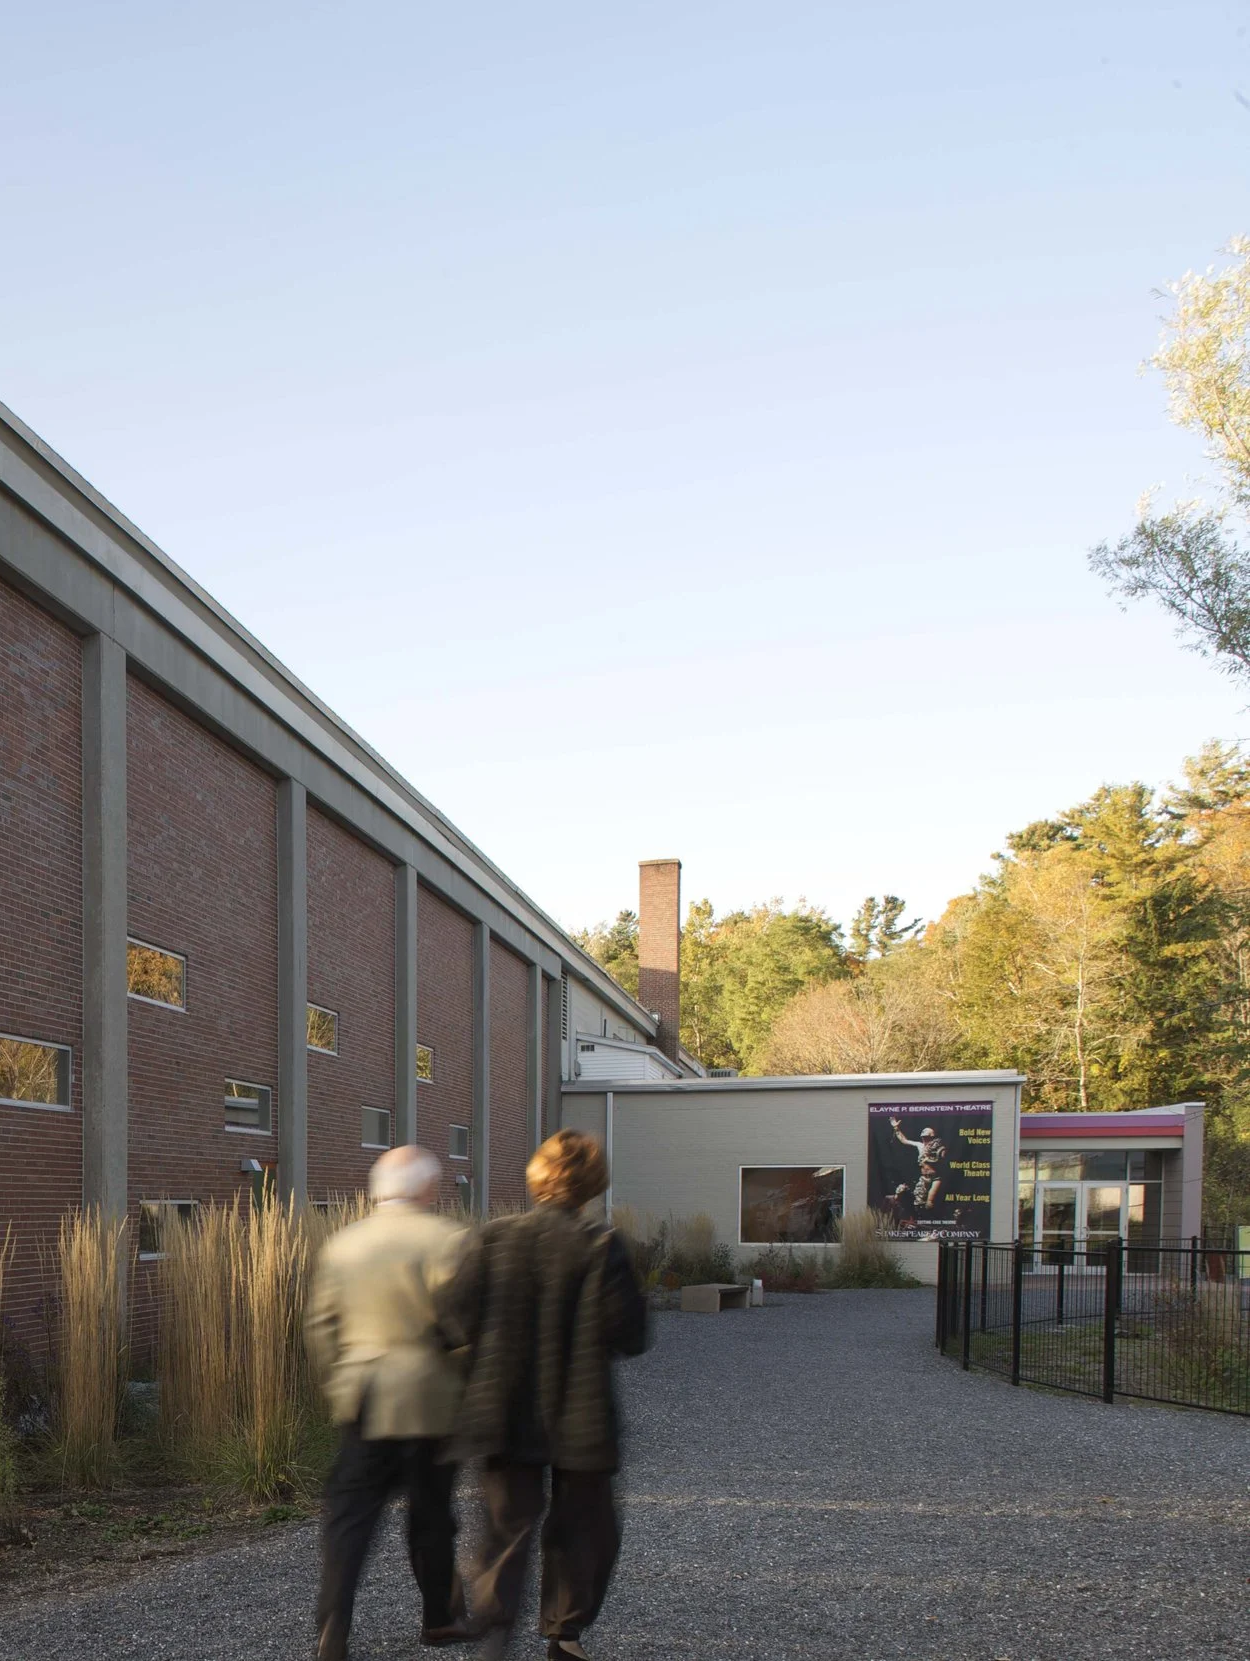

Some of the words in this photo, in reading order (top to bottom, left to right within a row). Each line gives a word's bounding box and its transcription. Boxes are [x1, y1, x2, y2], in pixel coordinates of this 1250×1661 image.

[959, 1128, 975, 1136] Bold
[976, 1128, 991, 1136] New
[949, 1161, 970, 1169] World
[971, 1161, 990, 1169] Class
[963, 1169, 990, 1177] Theatre
[944, 1194, 954, 1202] All
[955, 1193, 971, 1201] Year
[973, 1193, 990, 1202] Long
[940, 1229, 981, 1239] COMPANY
